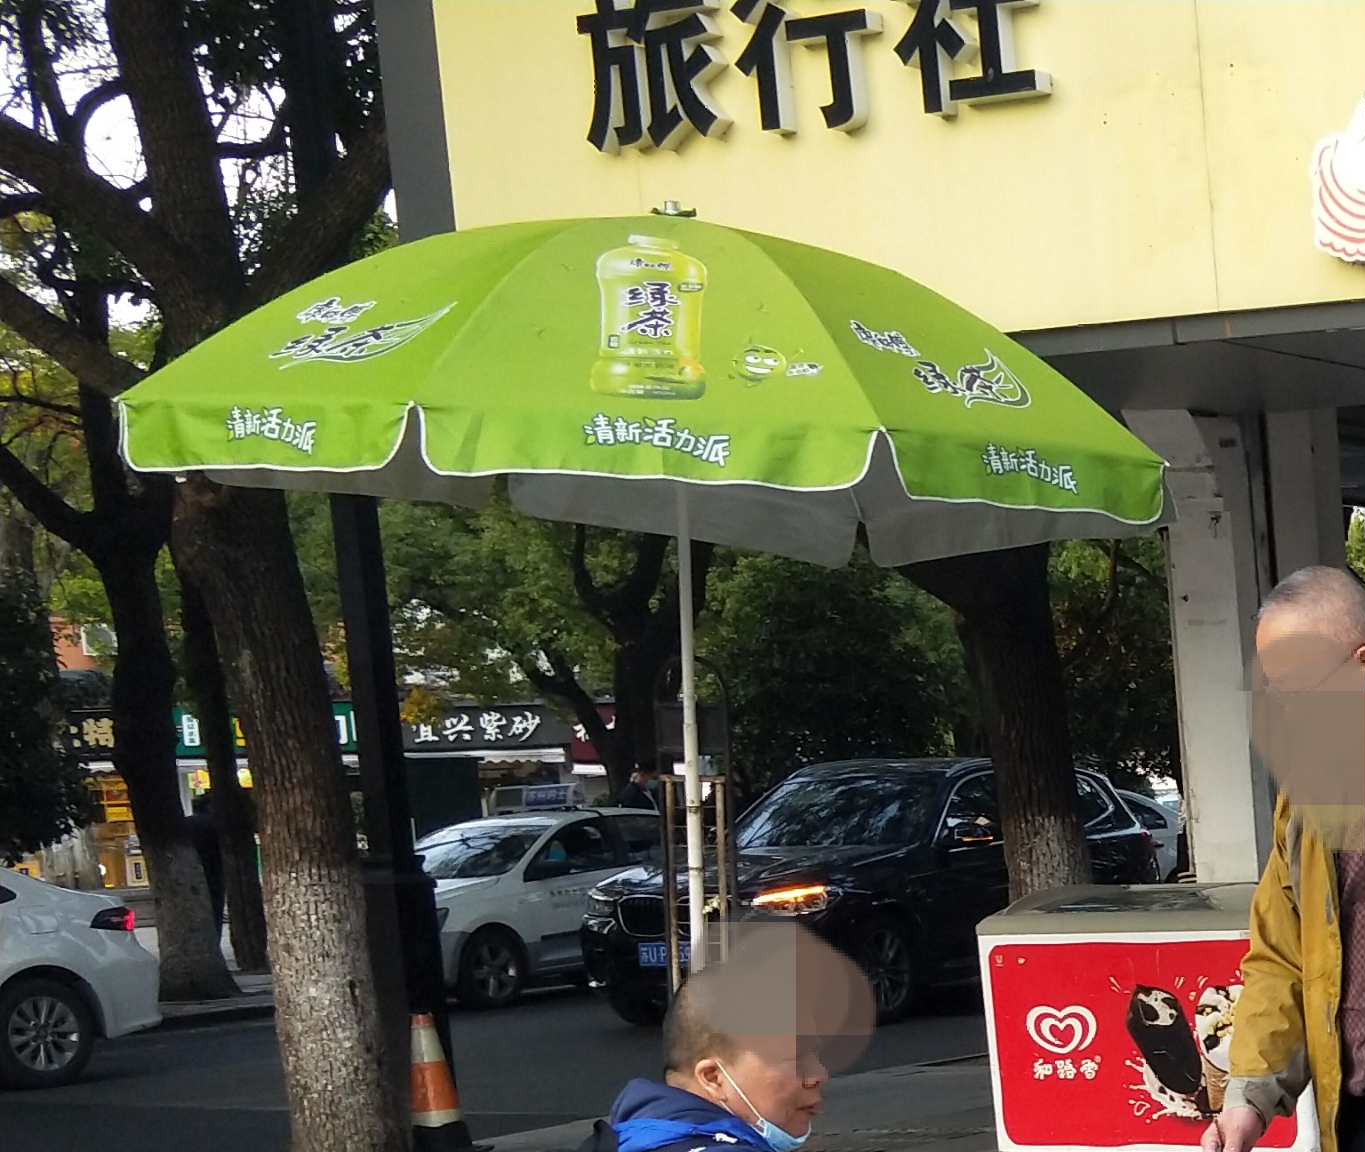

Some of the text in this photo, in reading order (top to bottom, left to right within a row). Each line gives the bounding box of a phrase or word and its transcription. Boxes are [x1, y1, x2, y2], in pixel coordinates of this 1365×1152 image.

[576, 0, 1053, 153] 旅行社
[620, 281, 682, 339] 绿茶
[227, 405, 318, 456] 清新活力派
[583, 413, 731, 468] 清新活力派
[982, 443, 1079, 496] 清新活力派
[411, 711, 541, 743] 宜兴紫砂
[1033, 1058, 1099, 1080] 和路雪
